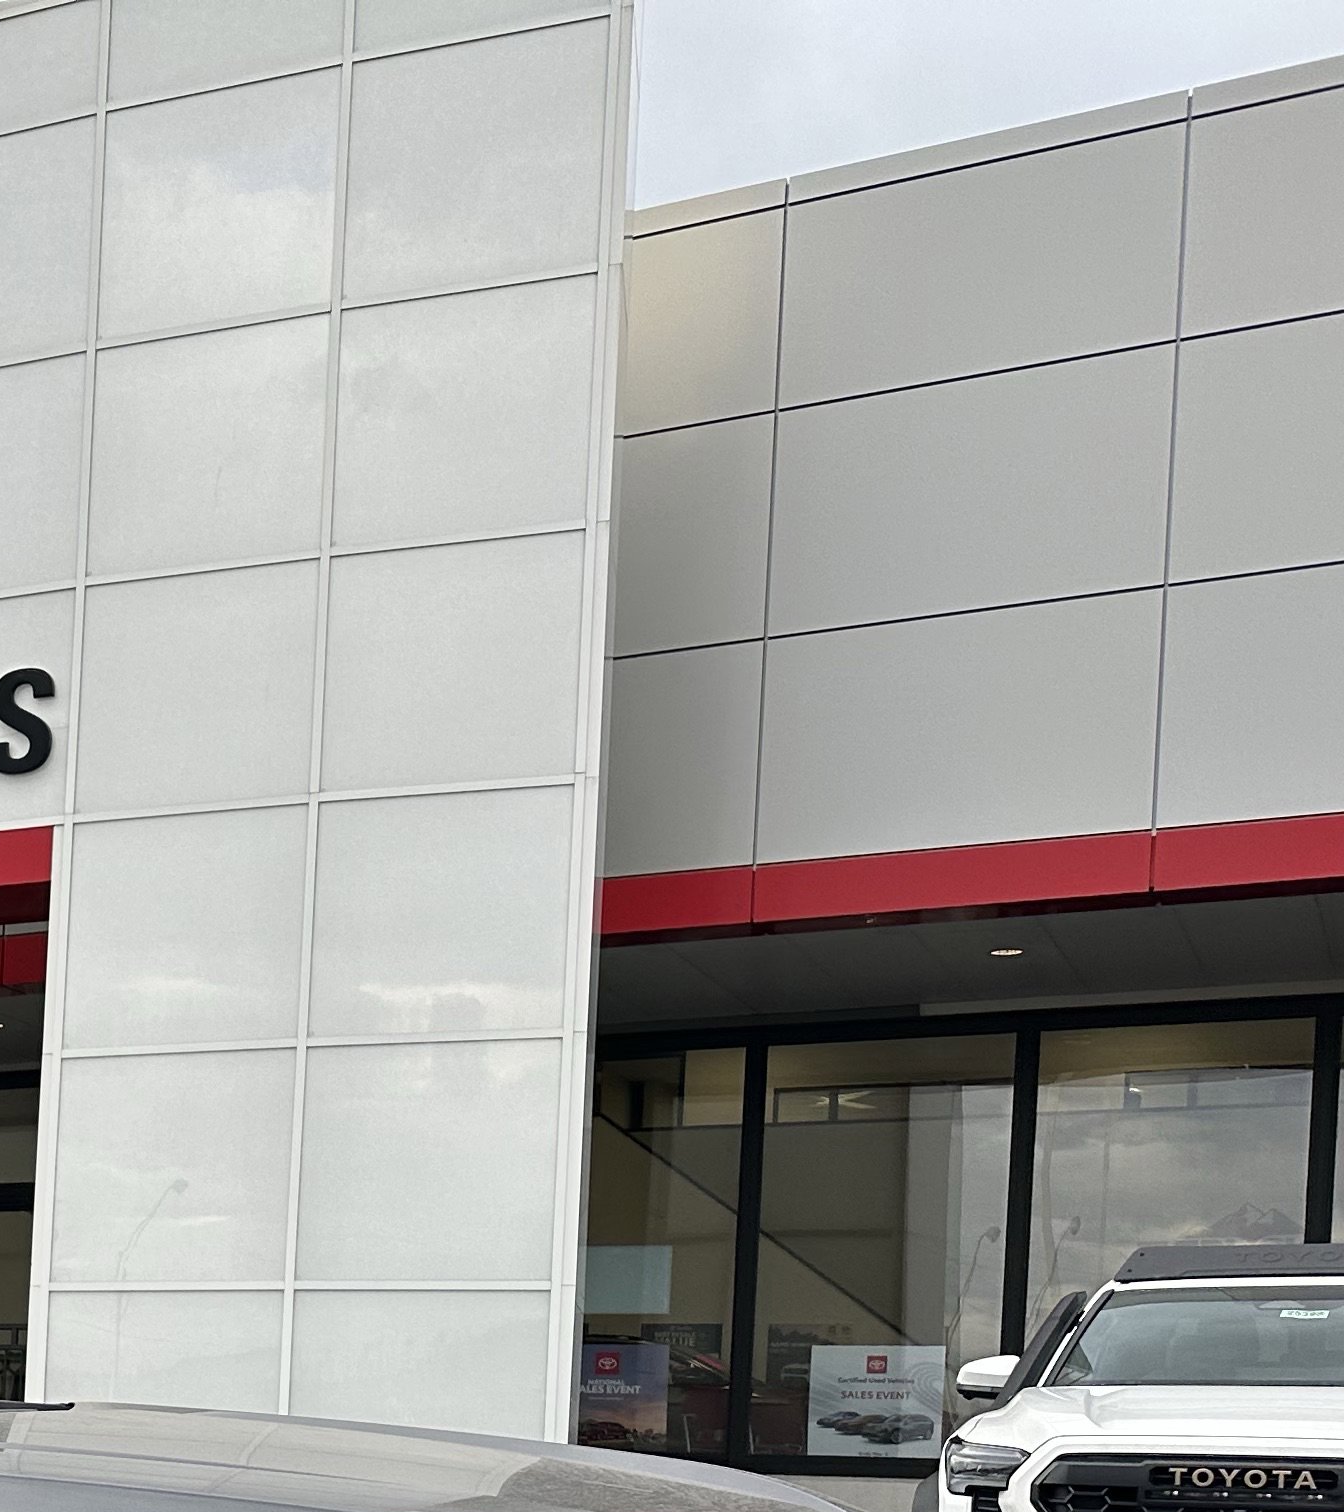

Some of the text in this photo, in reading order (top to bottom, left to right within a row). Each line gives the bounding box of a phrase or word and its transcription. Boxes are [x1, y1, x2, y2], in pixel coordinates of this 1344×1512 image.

[580, 1384, 641, 1394] ALES EVENT
[841, 1390, 911, 1400] SALES EVENT
[1168, 1467, 1317, 1490] TOYOTA
